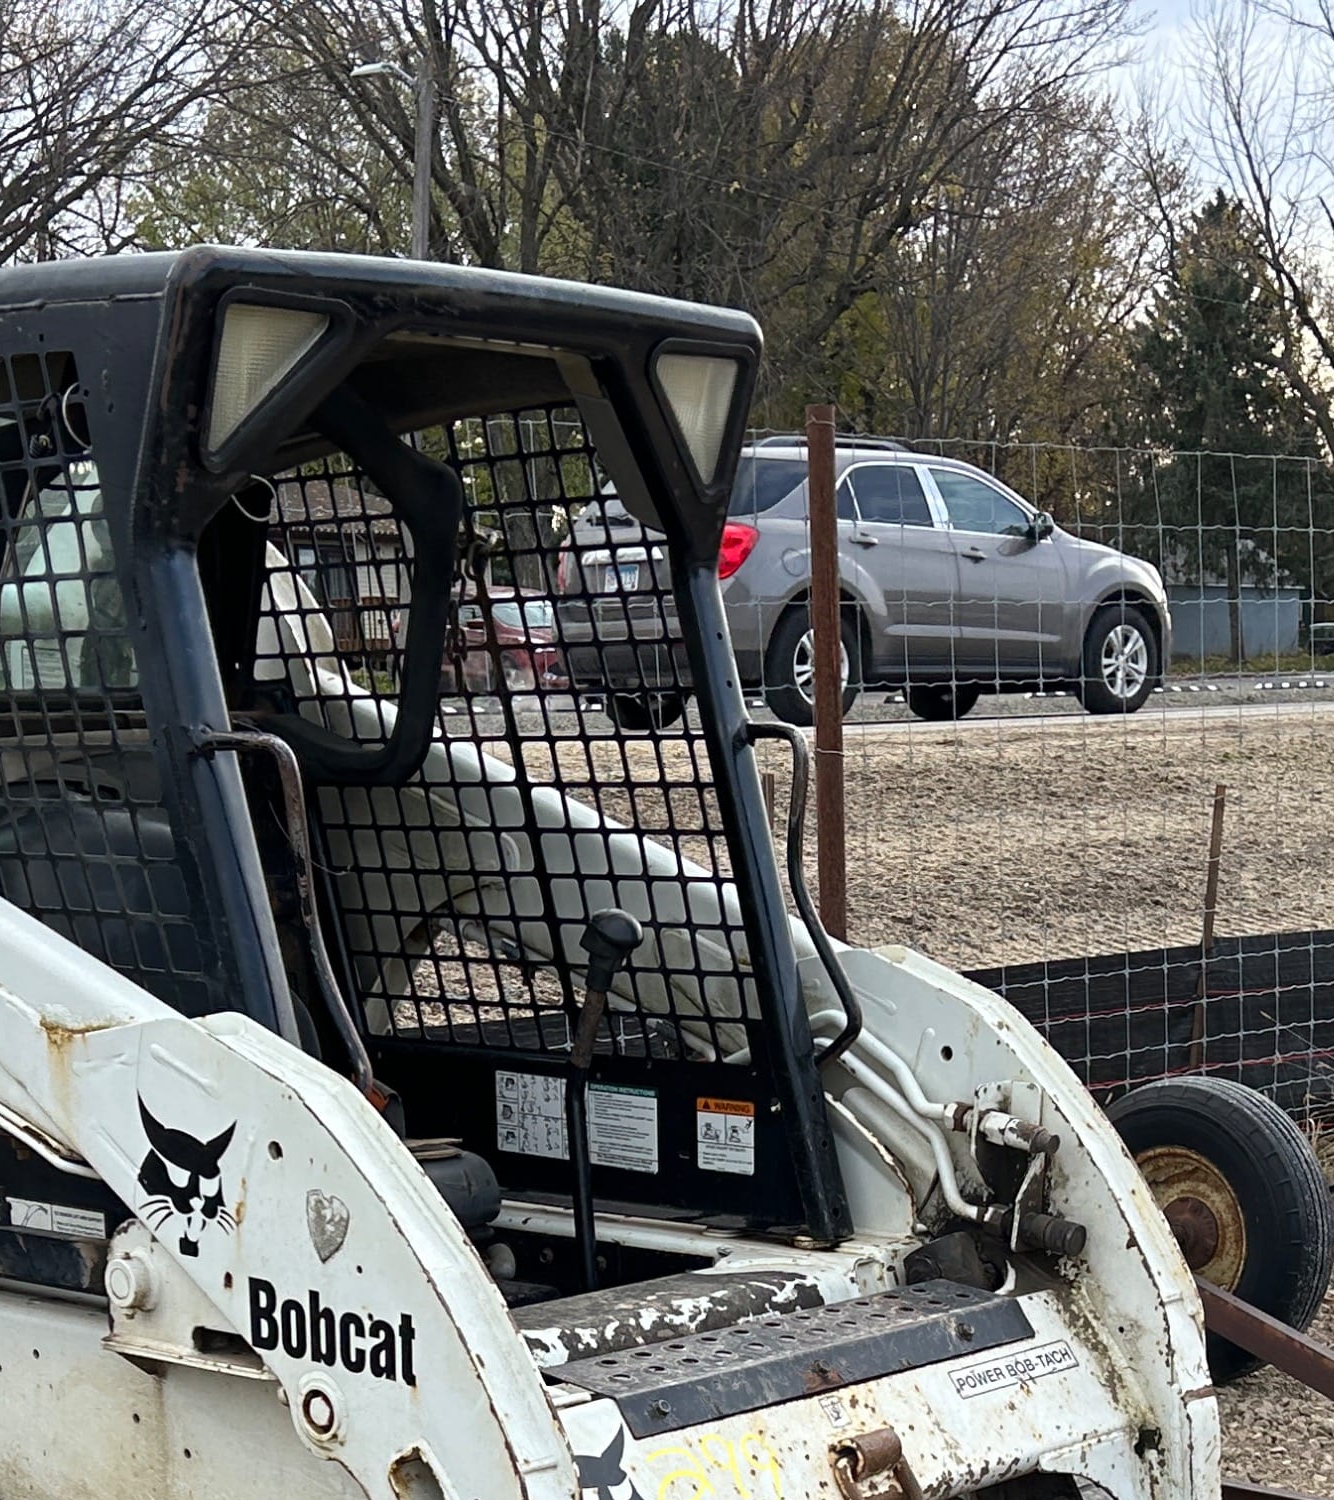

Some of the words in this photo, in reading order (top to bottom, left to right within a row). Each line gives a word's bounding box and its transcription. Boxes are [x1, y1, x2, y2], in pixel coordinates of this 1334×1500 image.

[714, 1102, 751, 1114] WARNING
[248, 1276, 416, 1387] Bobcat
[957, 1367, 1006, 1391] POWER
[1005, 1347, 1072, 1378] BOB-TACH
